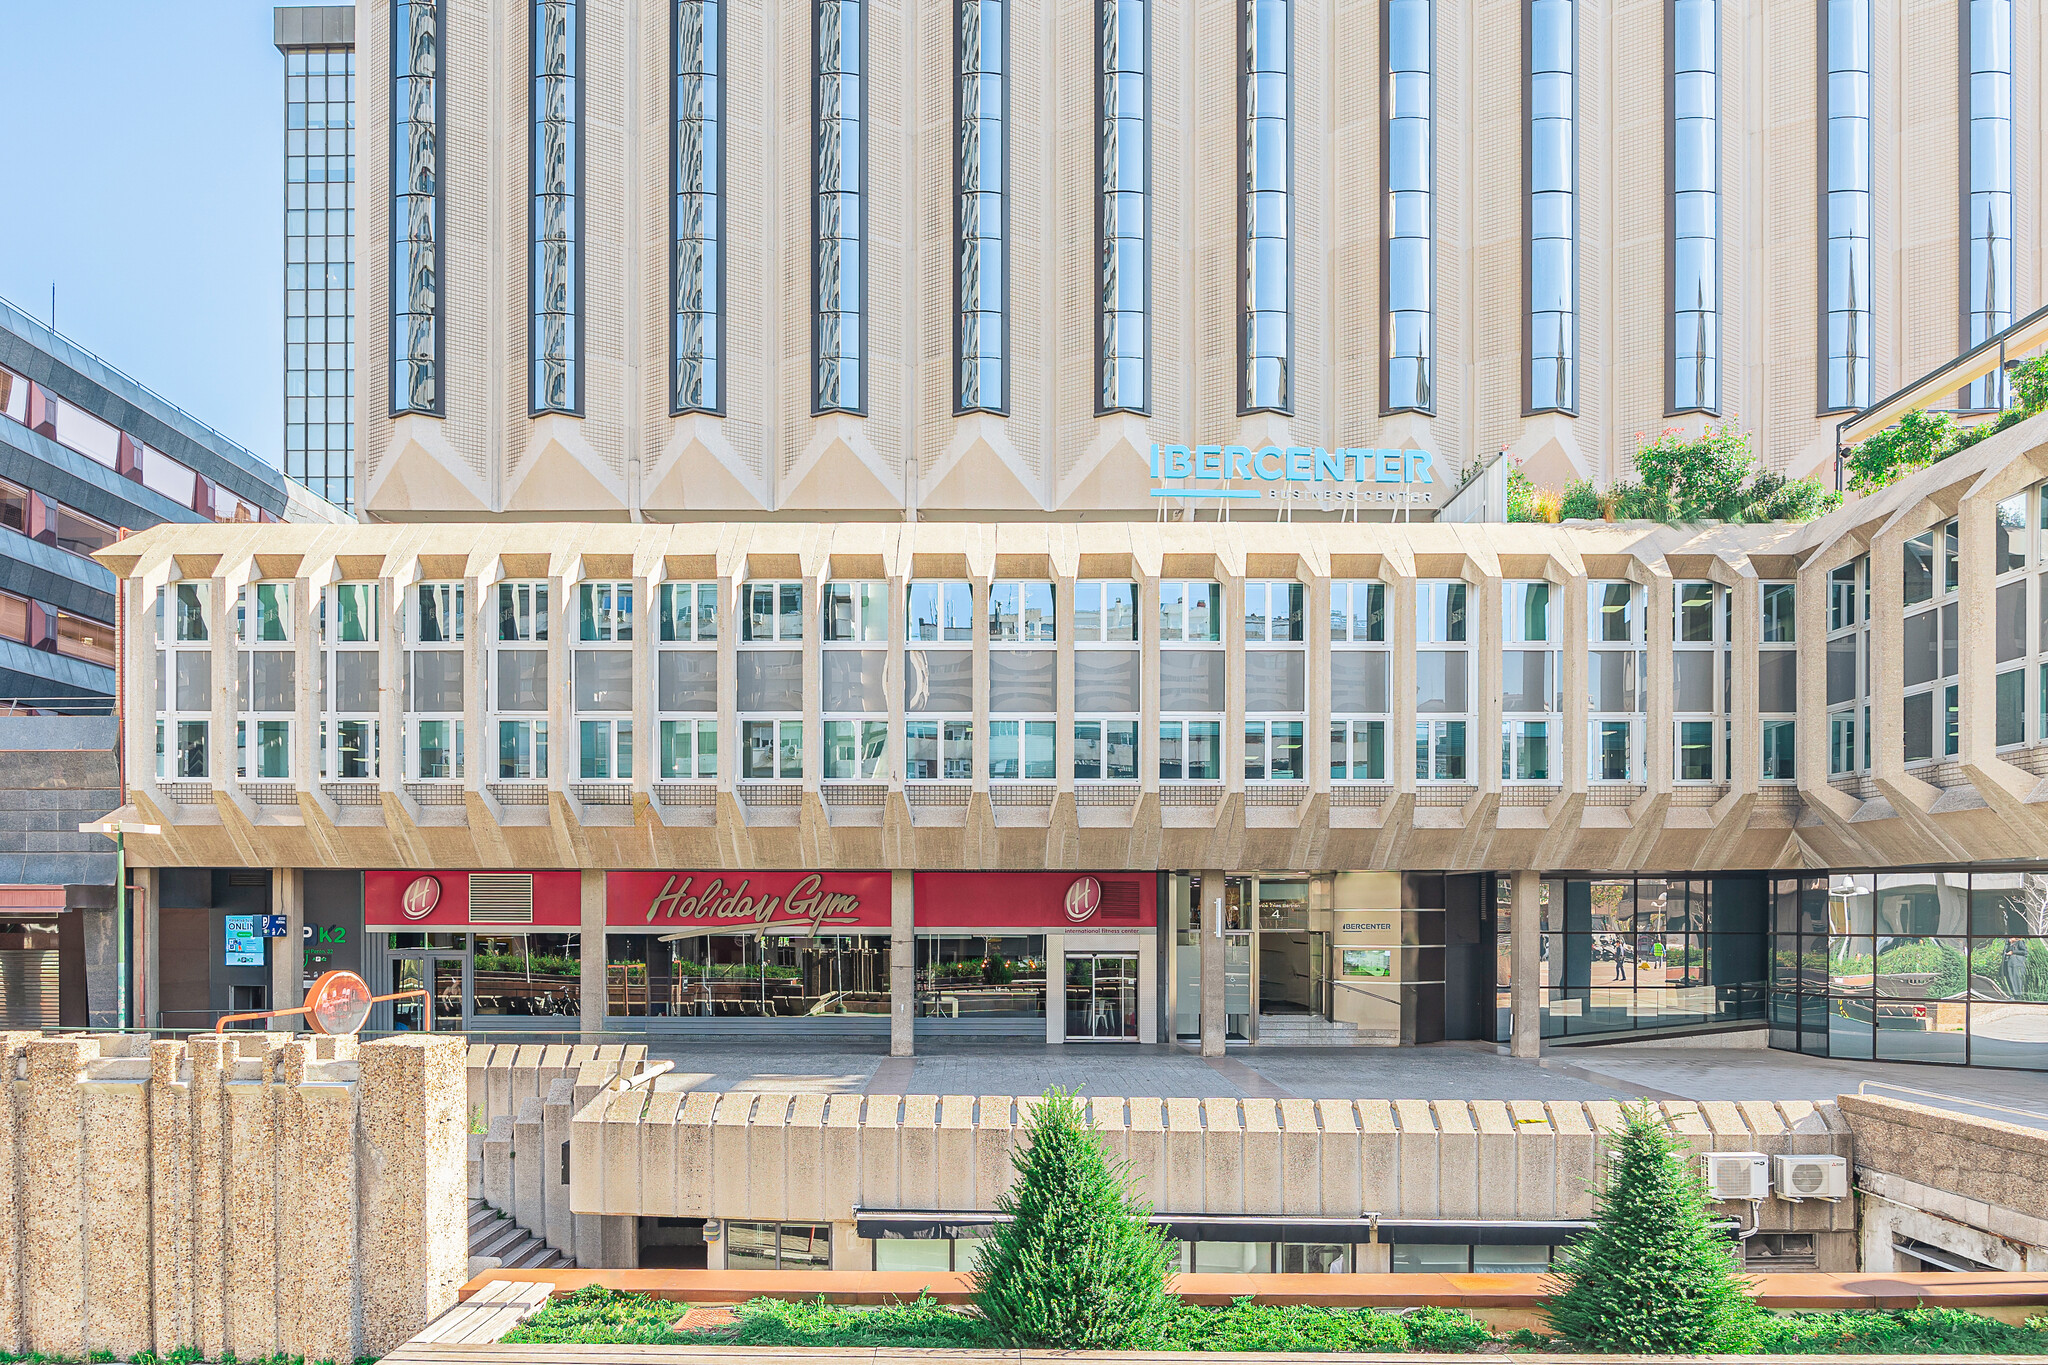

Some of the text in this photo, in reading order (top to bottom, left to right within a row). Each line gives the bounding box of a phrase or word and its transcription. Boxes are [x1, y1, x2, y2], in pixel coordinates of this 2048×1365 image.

[1150, 443, 1433, 484] IBERCENTER
[1269, 488, 1432, 503] BUSINESS CENTER
[646, 873, 859, 943] Holiday Gym
[1271, 909, 1280, 919] 4
